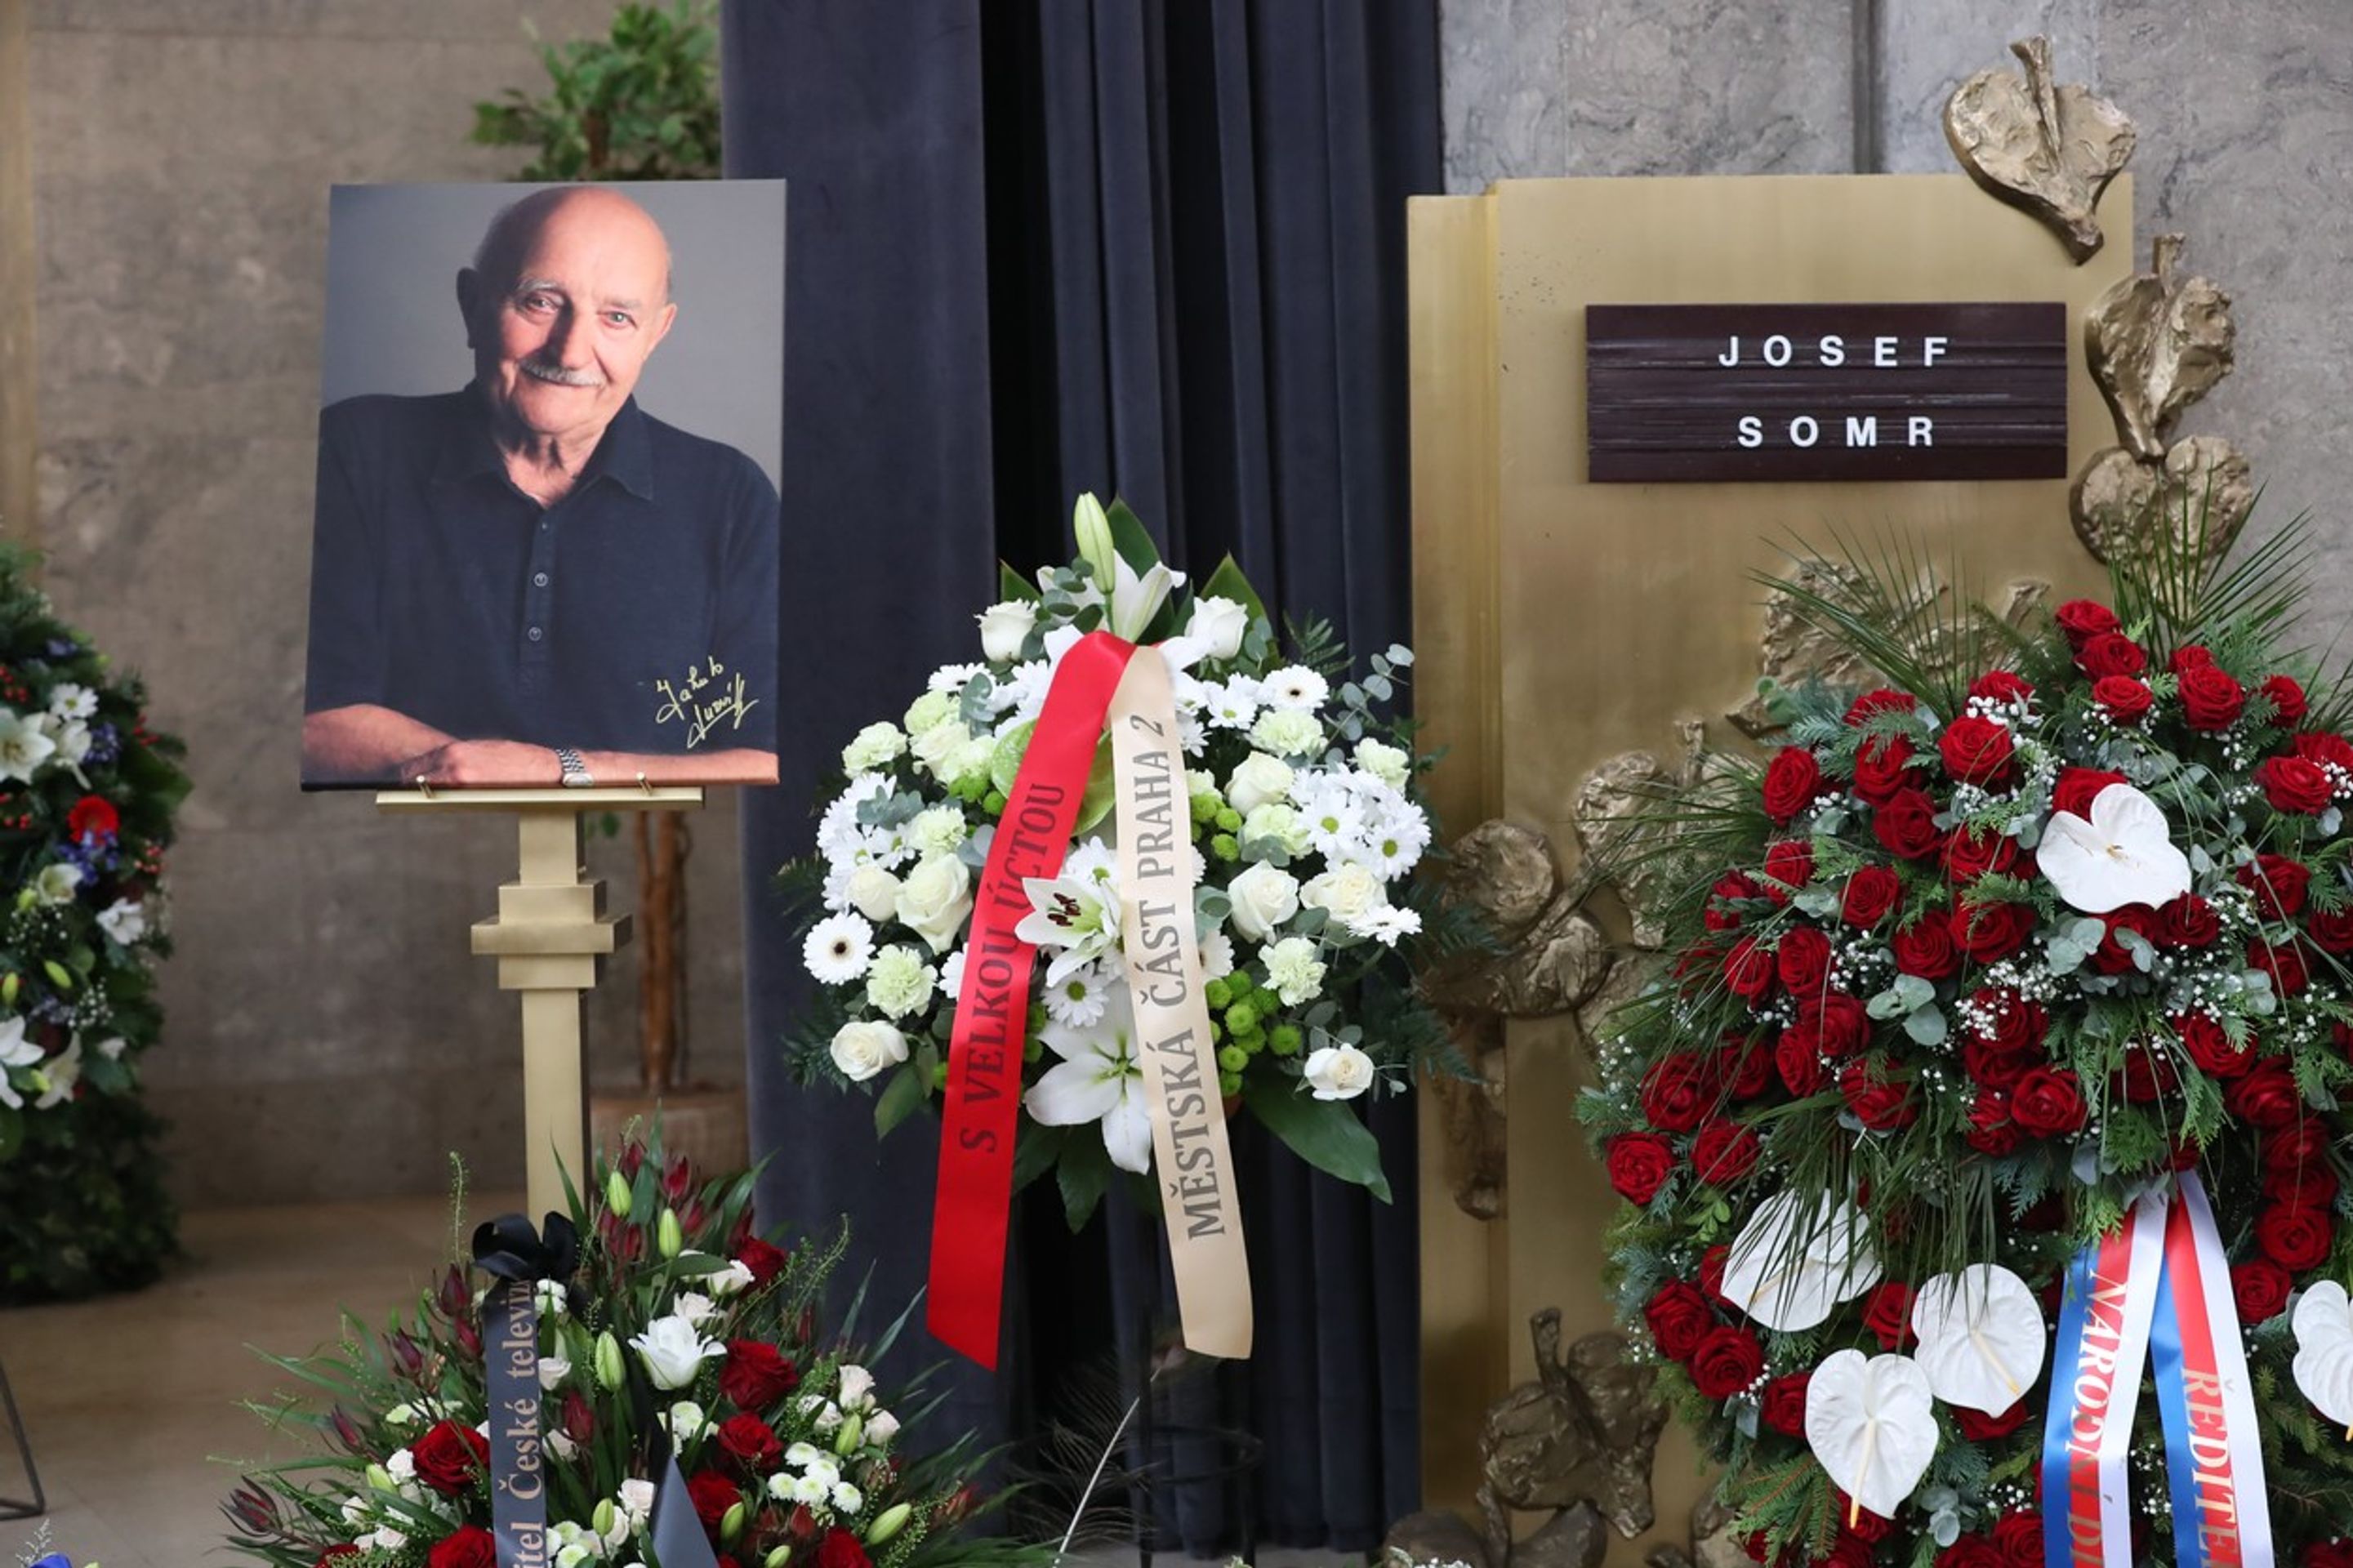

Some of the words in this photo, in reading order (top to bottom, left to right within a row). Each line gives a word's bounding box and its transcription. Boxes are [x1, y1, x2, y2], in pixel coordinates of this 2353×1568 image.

[1718, 335, 1948, 368] JOSEF
[1737, 416, 1934, 448] SOMR
[1130, 714, 1165, 737] 2
[986, 782, 1067, 913] ÚCTOU
[1132, 750, 1174, 880] PRAHA
[1134, 900, 1188, 1009] ČÁST
[963, 938, 1019, 1106] VELKOU
[960, 1128, 997, 1154] S
[1145, 1027, 1226, 1241] MĚSTSKÁ
[498, 1397, 543, 1500] České
